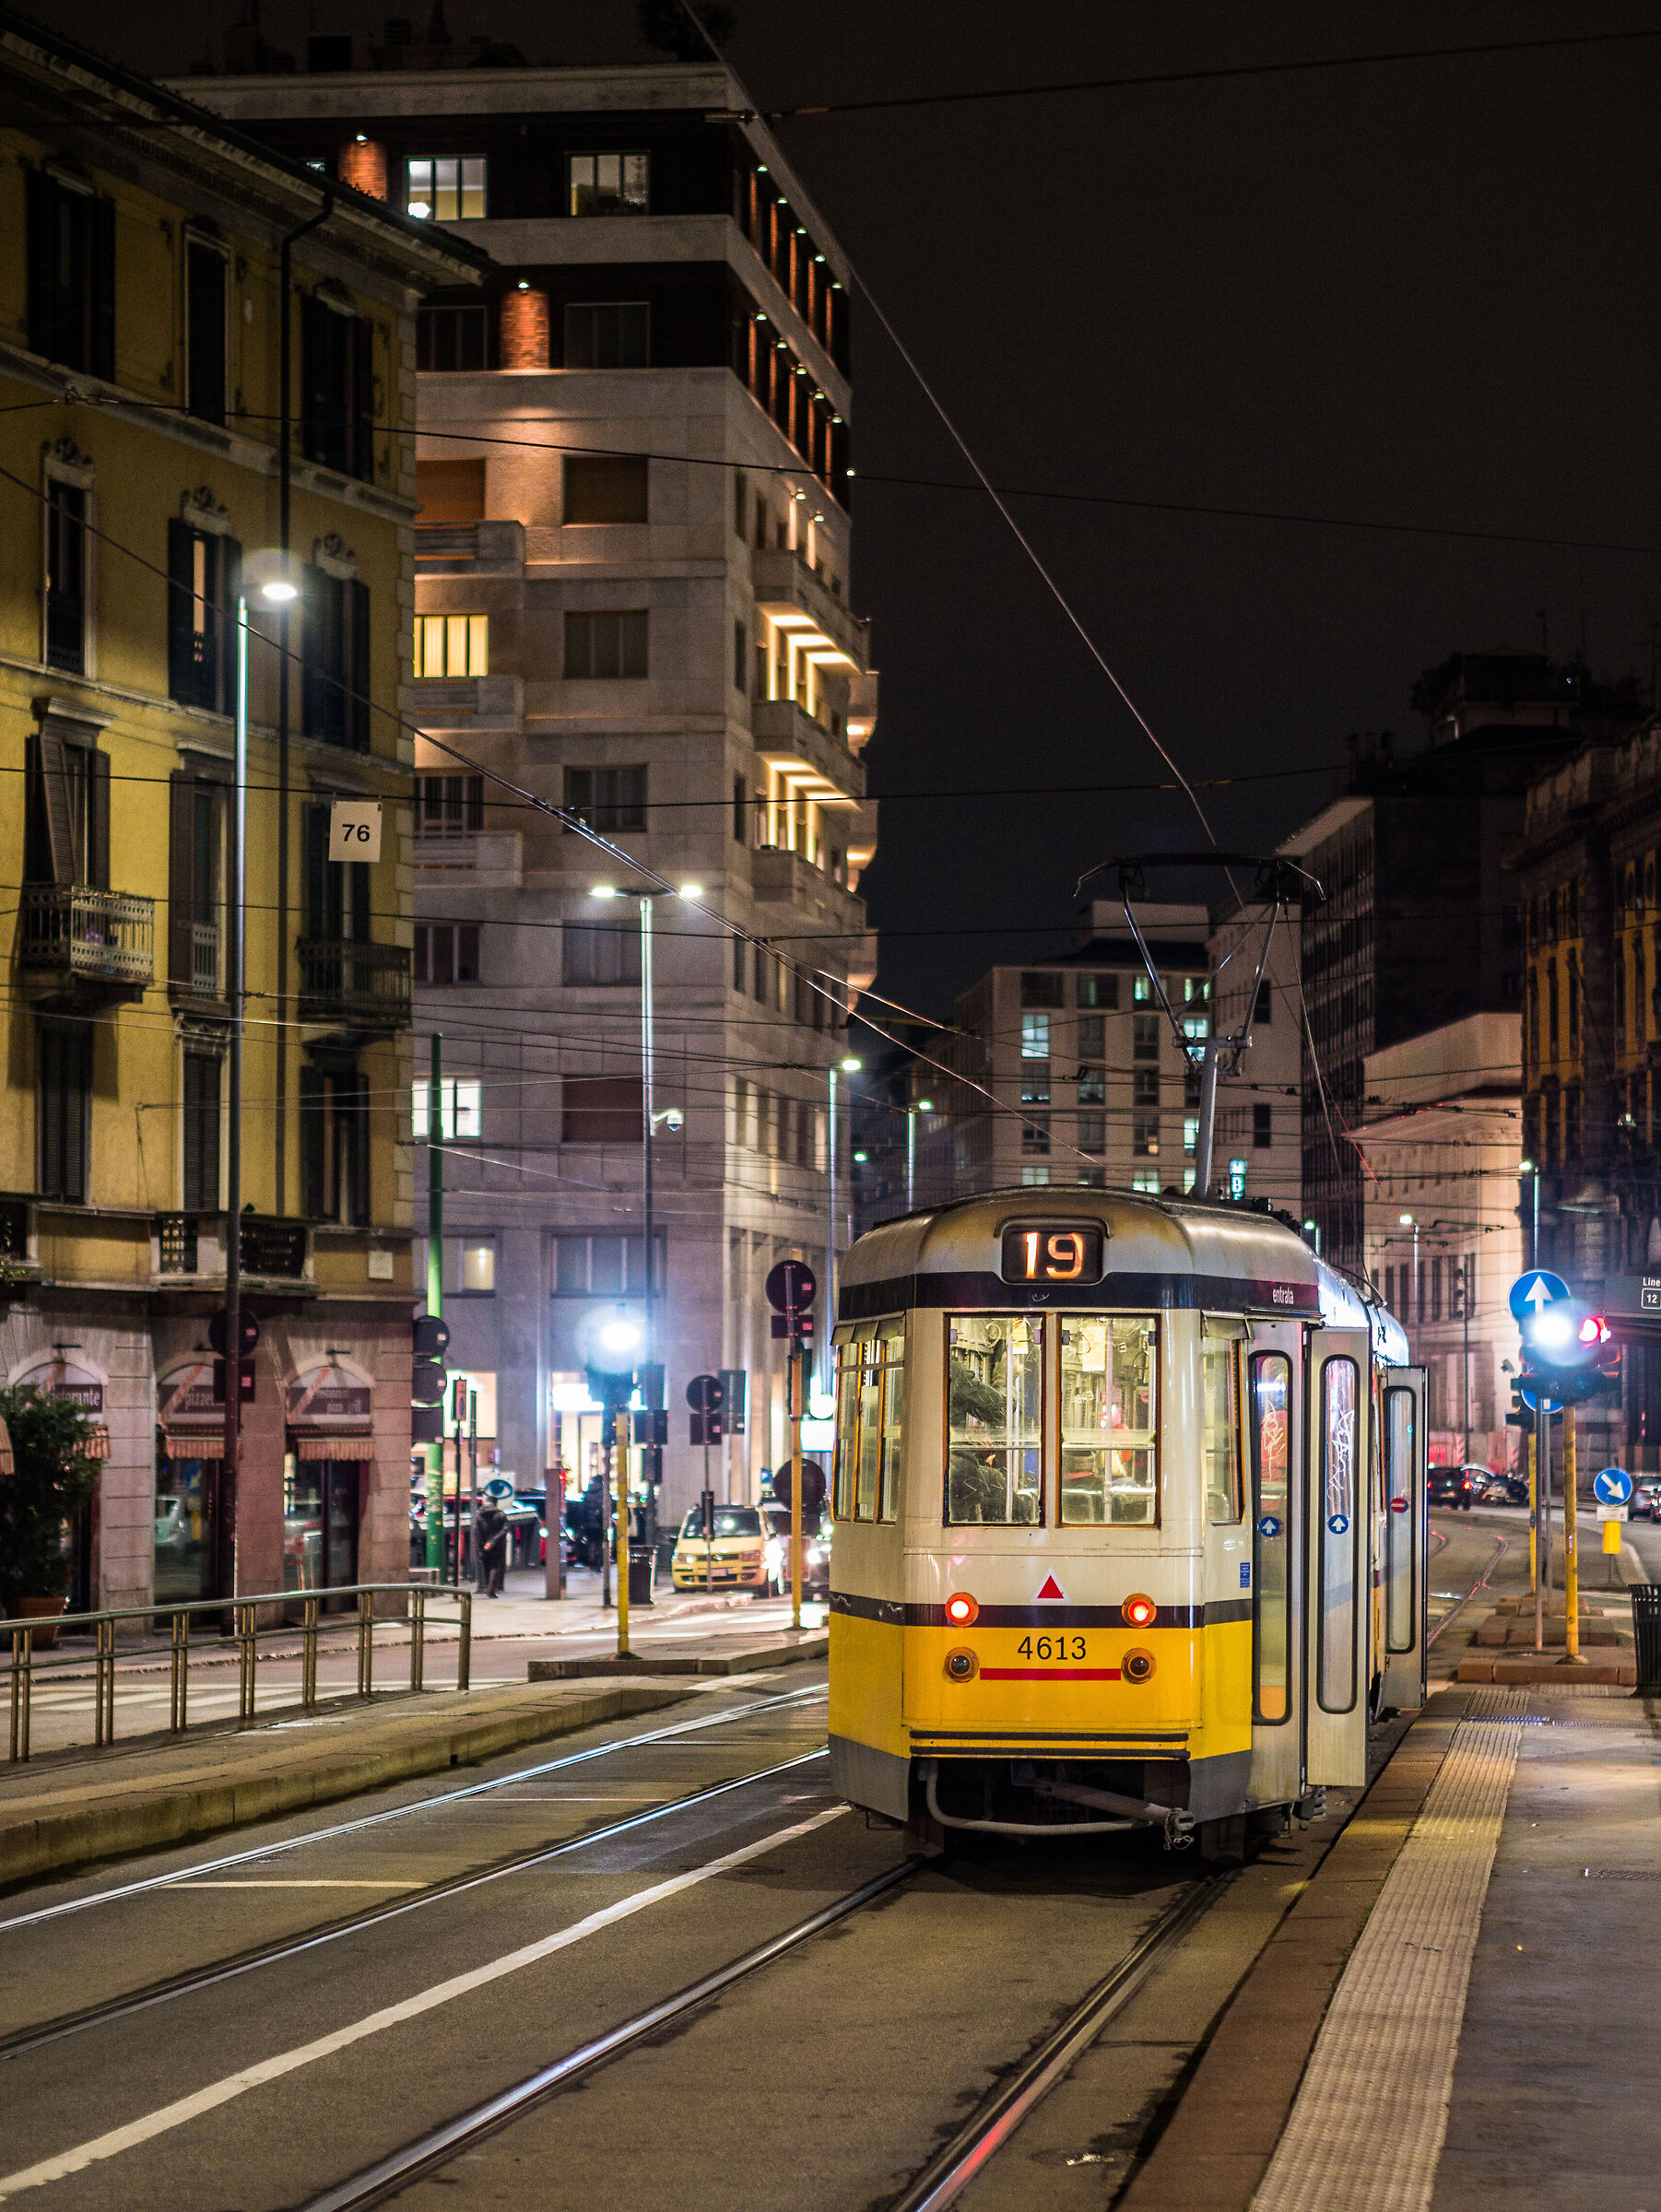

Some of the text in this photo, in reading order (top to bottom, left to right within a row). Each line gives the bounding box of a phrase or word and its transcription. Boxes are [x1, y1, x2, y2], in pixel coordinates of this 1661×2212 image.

[341, 824, 371, 842] 76
[1024, 1231, 1084, 1279] 19
[1272, 1286, 1294, 1304] entrata
[1646, 1293, 1657, 1304] 12
[1017, 1636, 1086, 1660] 4613
